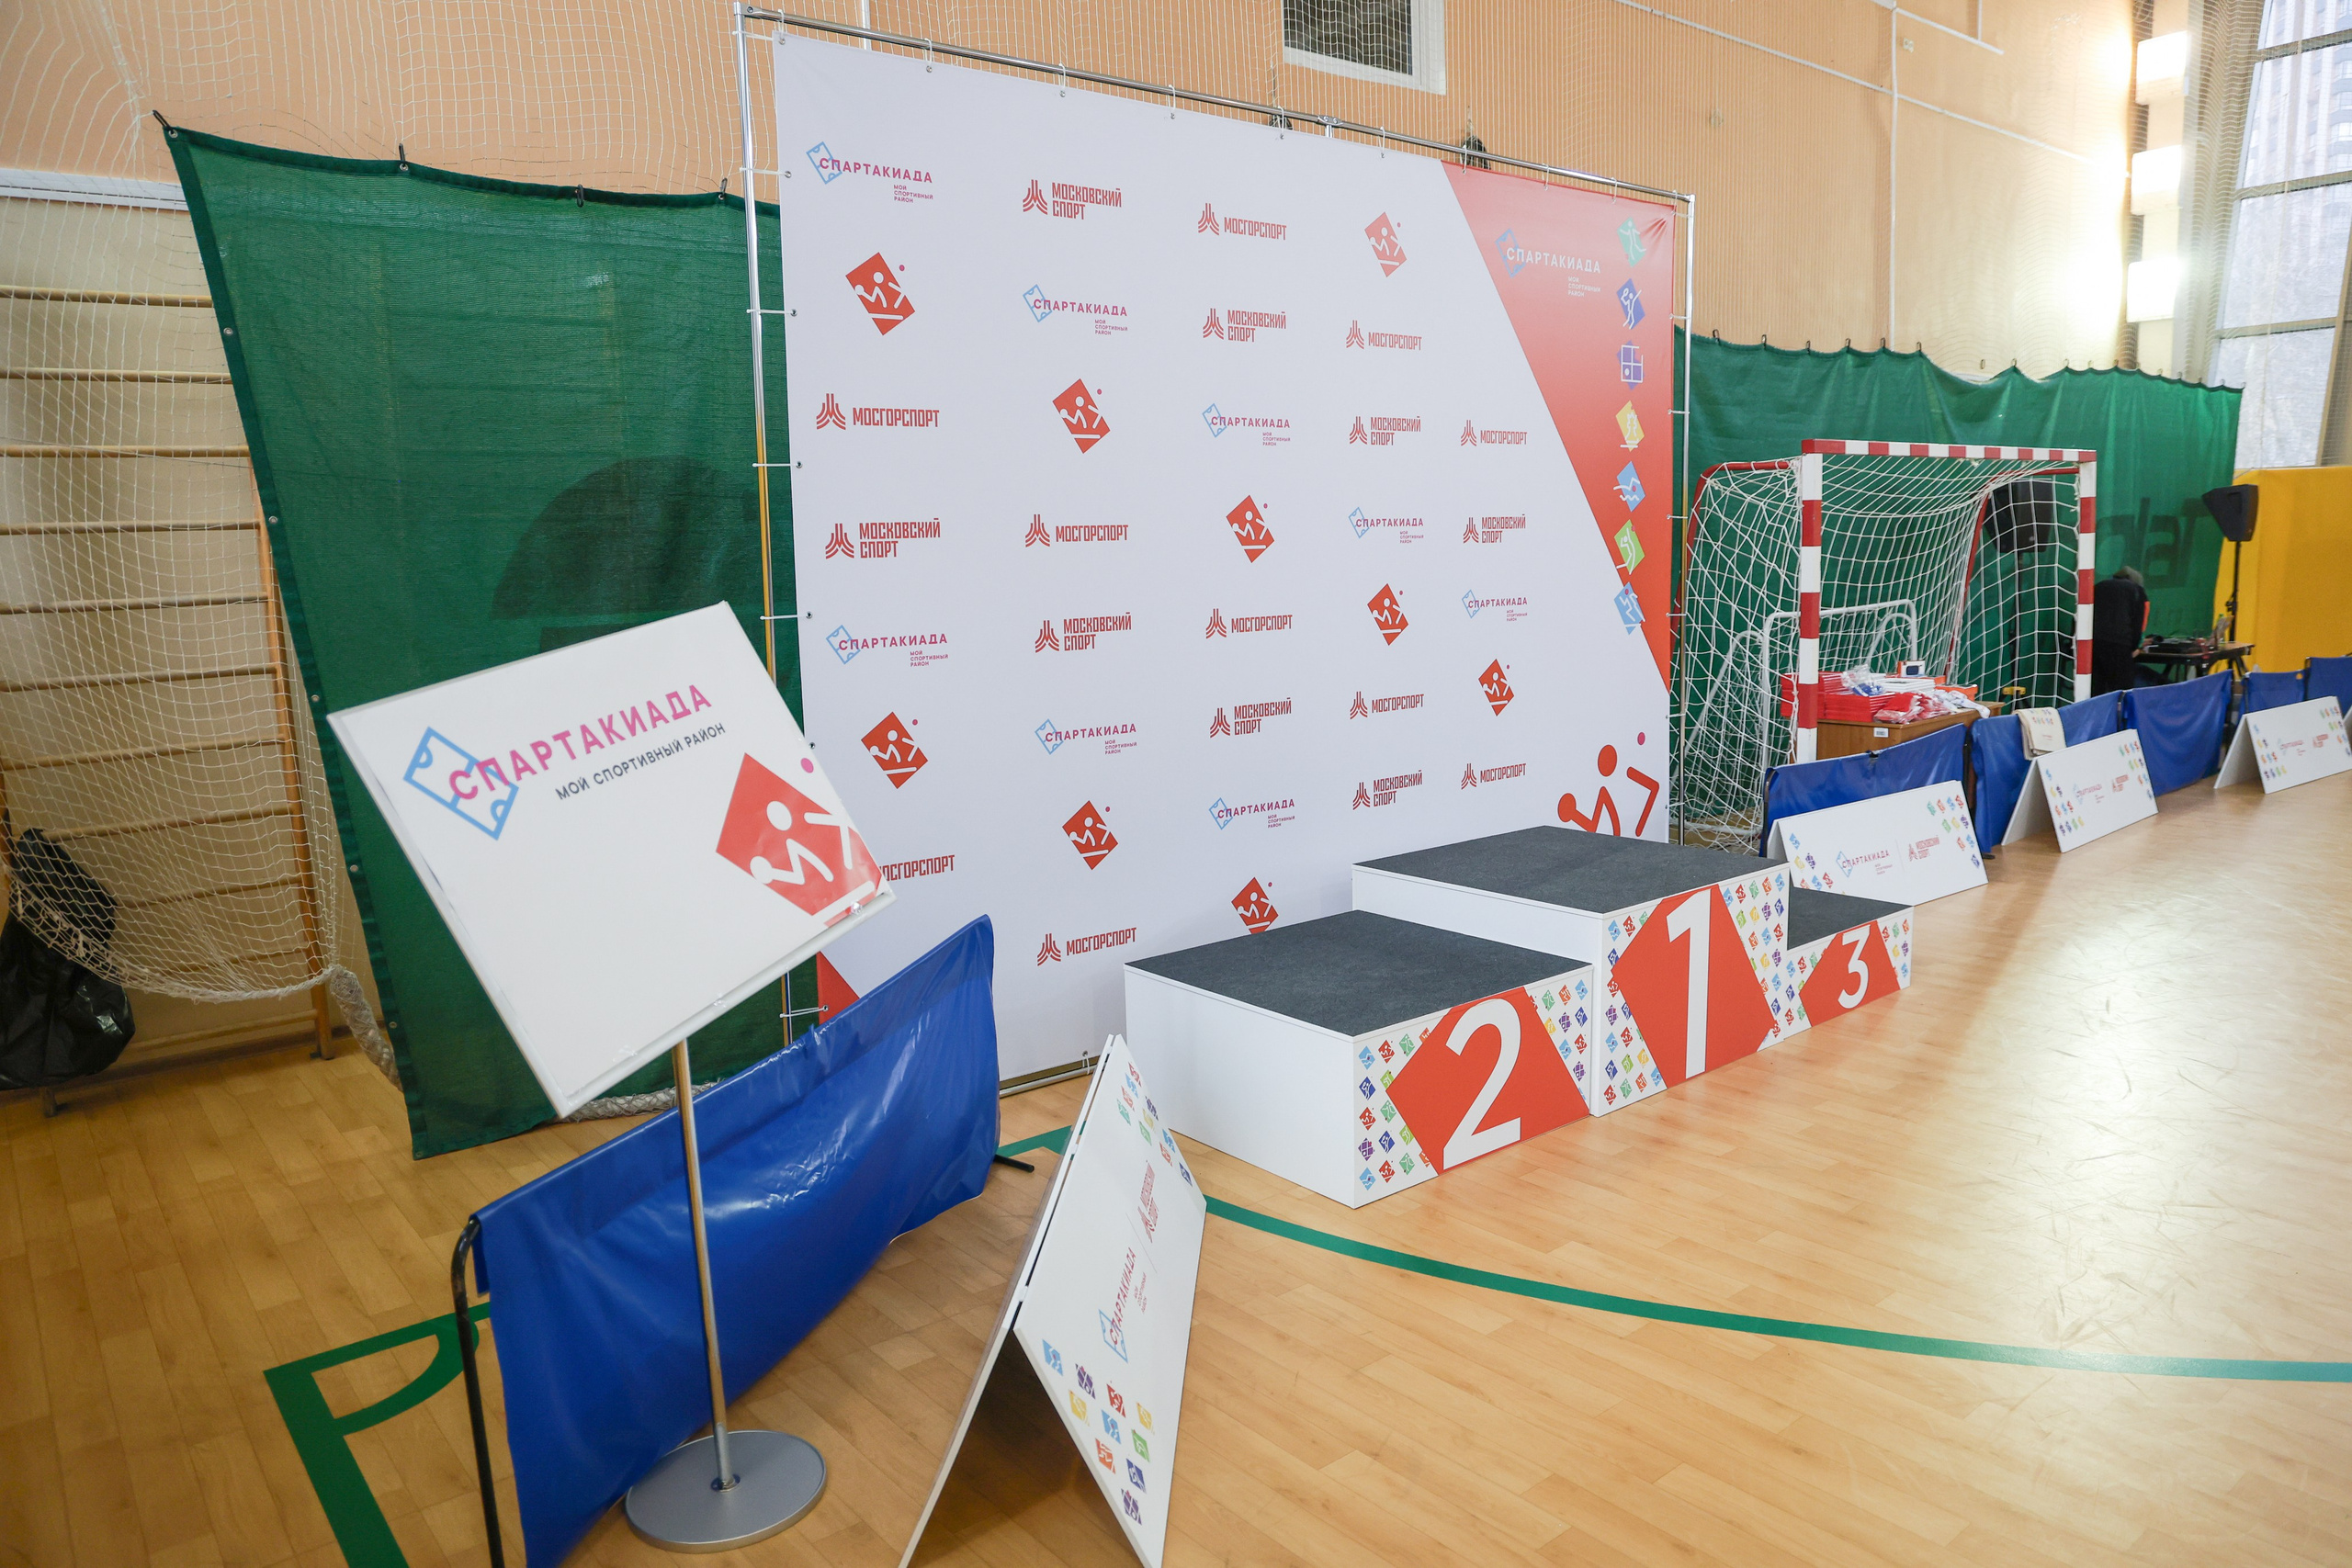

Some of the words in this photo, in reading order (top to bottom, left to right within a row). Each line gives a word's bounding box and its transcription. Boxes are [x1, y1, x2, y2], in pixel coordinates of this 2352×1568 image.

[819, 157, 933, 183] СПАРТАКИАДА
[1052, 182, 1122, 208] МОСКОВСКИЙ
[1052, 200, 1085, 220] СПОРТ
[1224, 217, 1286, 241] МОСГОРСПОРТ
[1506, 248, 1600, 273] СПАРТАКИАДА
[1033, 299, 1127, 317] СПАРТАКИАДА
[1227, 310, 1286, 329] МОСКОВСКИЙ
[1228, 327, 1255, 343] СПОРТ
[1368, 332, 1422, 350] МОСГОРСПОРТ
[853, 408, 939, 427] МОСГОРСПОРТ
[1211, 417, 1290, 428] СПАРТАКИАДА
[1371, 416, 1420, 433] МОСКОВСКИЙ
[1371, 433, 1395, 446] СПОРТ
[1480, 430, 1527, 445] МОСГОРСПОРТ
[859, 518, 940, 540] МОСКОВСКИЙ
[1356, 518, 1423, 527] СПАРТАКИАДА
[1482, 514, 1526, 529] МОСКОВСКИЙ
[1056, 525, 1128, 542] МОСГОРСПОРТ
[1482, 530, 1502, 543] СПОРТ
[860, 540, 899, 558] СПОРТ
[1468, 597, 1527, 608] СПАРТАКИАДА
[1064, 612, 1131, 634] МОСКОВСКИЙ
[1231, 615, 1293, 633] МОСГОРСПОРТ
[839, 633, 947, 650] СПАРТАКИАДА
[1064, 634, 1096, 651] СПОРТ
[1234, 697, 1292, 720] МОСКОВСКИЙ
[1372, 694, 1424, 714] МОСГОРСПОРТ
[1046, 723, 1136, 742] СПАРТАКИАДА
[1234, 718, 1261, 735] СПОРТ
[448, 684, 712, 800] СПАРТАКИАДА
[555, 776, 590, 800] МОЙ
[594, 739, 684, 784] СПОРТИВНЫЙ
[684, 723, 725, 748] РАЙОН
[1374, 770, 1422, 793] МОСКОВСКИЙ
[1480, 763, 1526, 783] МОСГОРСПОРТ
[1217, 798, 1295, 818] СПАРТАКИАДА
[1374, 790, 1396, 807] СПОРТ
[880, 854, 955, 881] ОСГОРСПОРТ
[1067, 927, 1136, 956] МОСГОРСПОРТ
[1838, 924, 1871, 1010] 3
[1667, 888, 1712, 1079] 1
[1442, 998, 1521, 1170] 2
